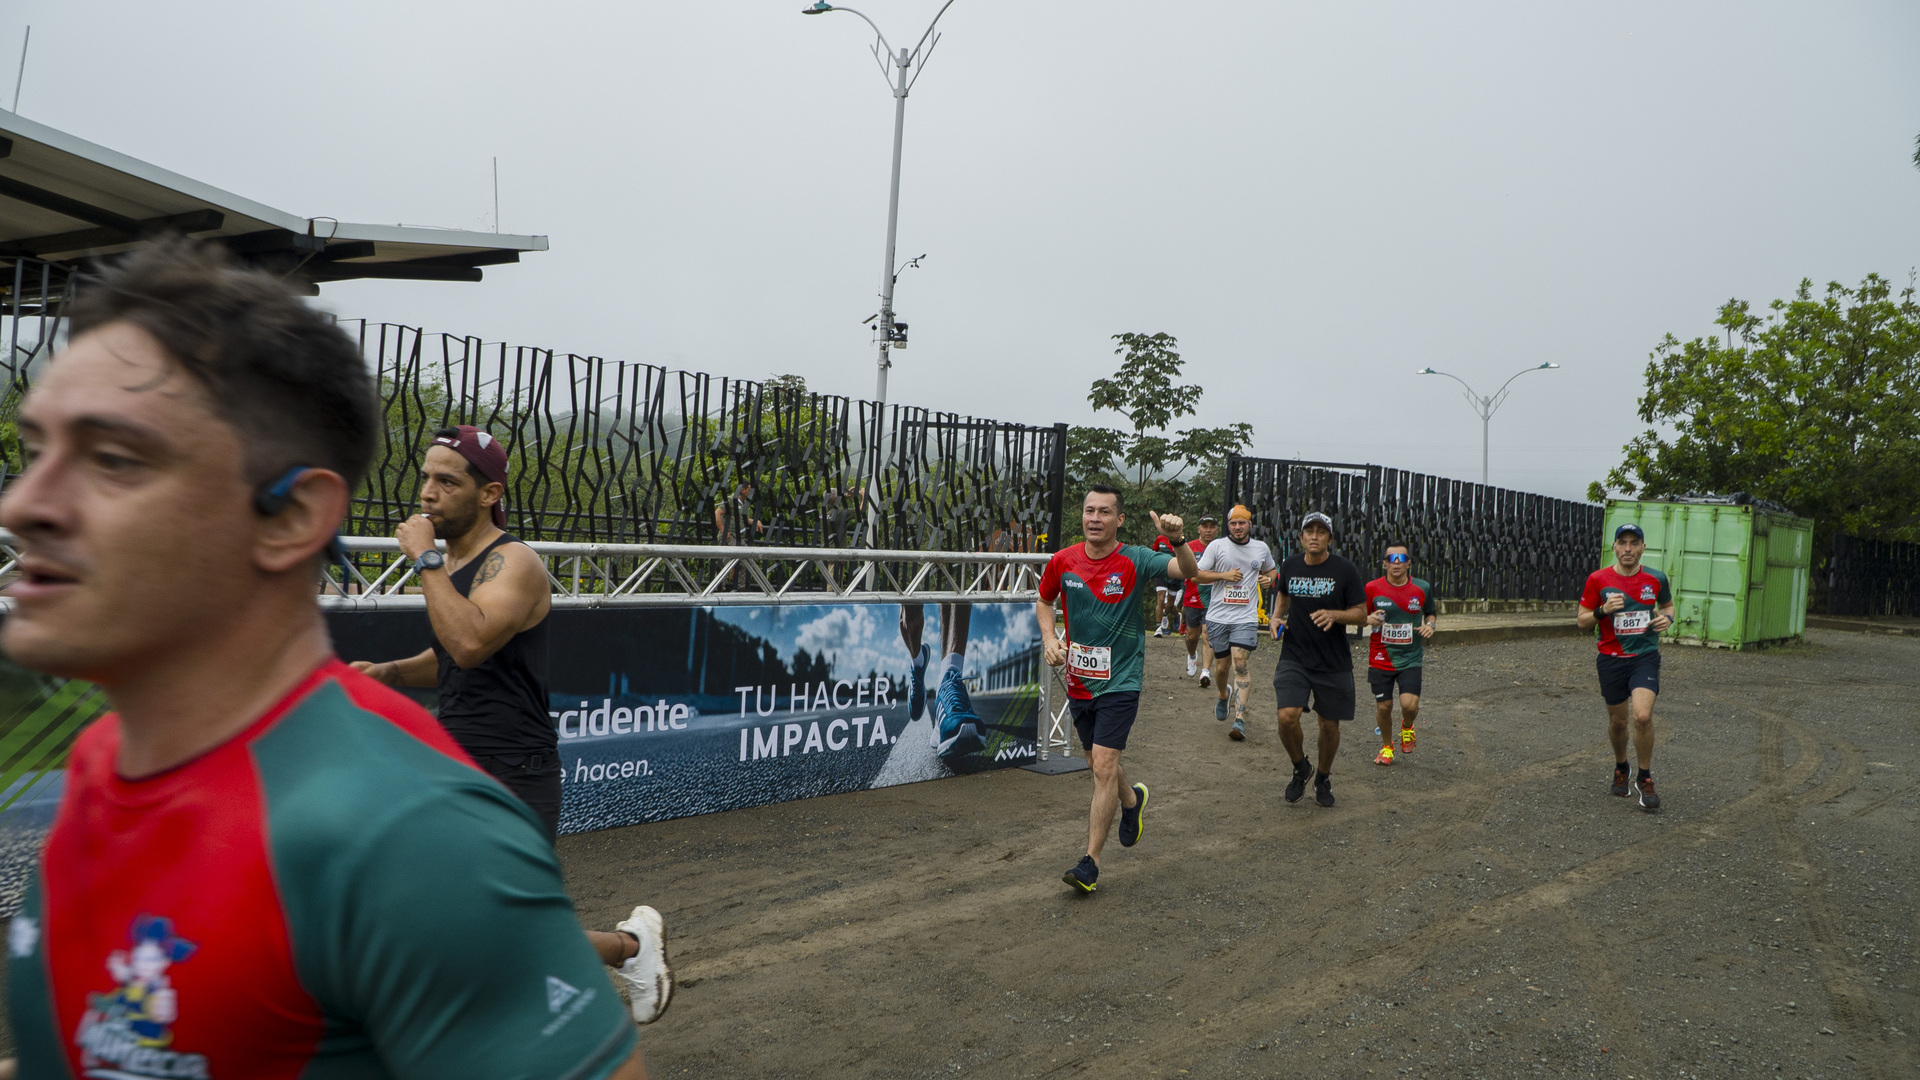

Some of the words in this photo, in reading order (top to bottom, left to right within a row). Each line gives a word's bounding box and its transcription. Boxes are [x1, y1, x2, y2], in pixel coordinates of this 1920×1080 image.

[1228, 590, 1247, 598] 2003
[1623, 619, 1640, 627] 887
[1386, 630, 1408, 638] 1859
[1077, 654, 1098, 669] 790
[735, 684, 776, 718] TU
[790, 677, 897, 714] HACER,
[739, 715, 897, 761] IMPACTA.
[994, 744, 1036, 762] AVAL
[574, 758, 653, 783] hacen.
